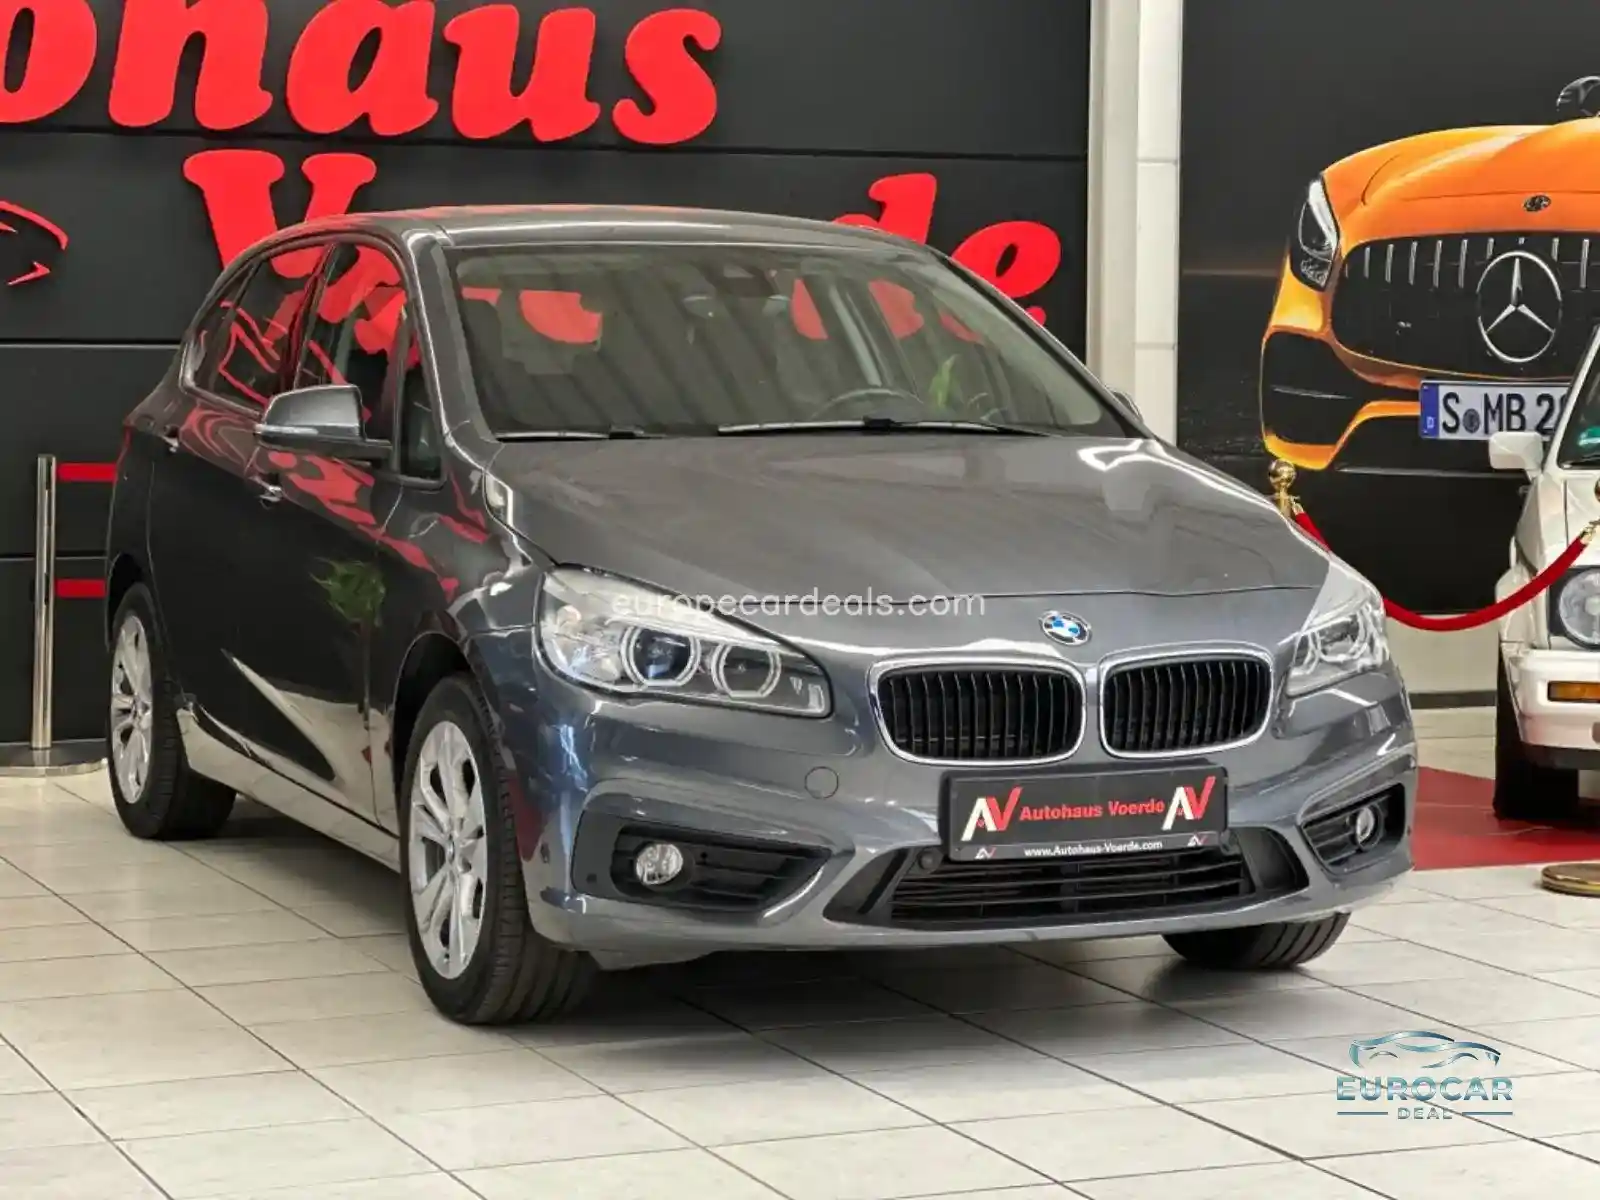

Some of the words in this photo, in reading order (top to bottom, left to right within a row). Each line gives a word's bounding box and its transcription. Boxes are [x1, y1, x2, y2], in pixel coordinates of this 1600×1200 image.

[1018, 804, 1104, 822] Autohaus
[1107, 799, 1165, 817] Voerde
[1023, 839, 1163, 858] www.Autohaus-Voerde.com
